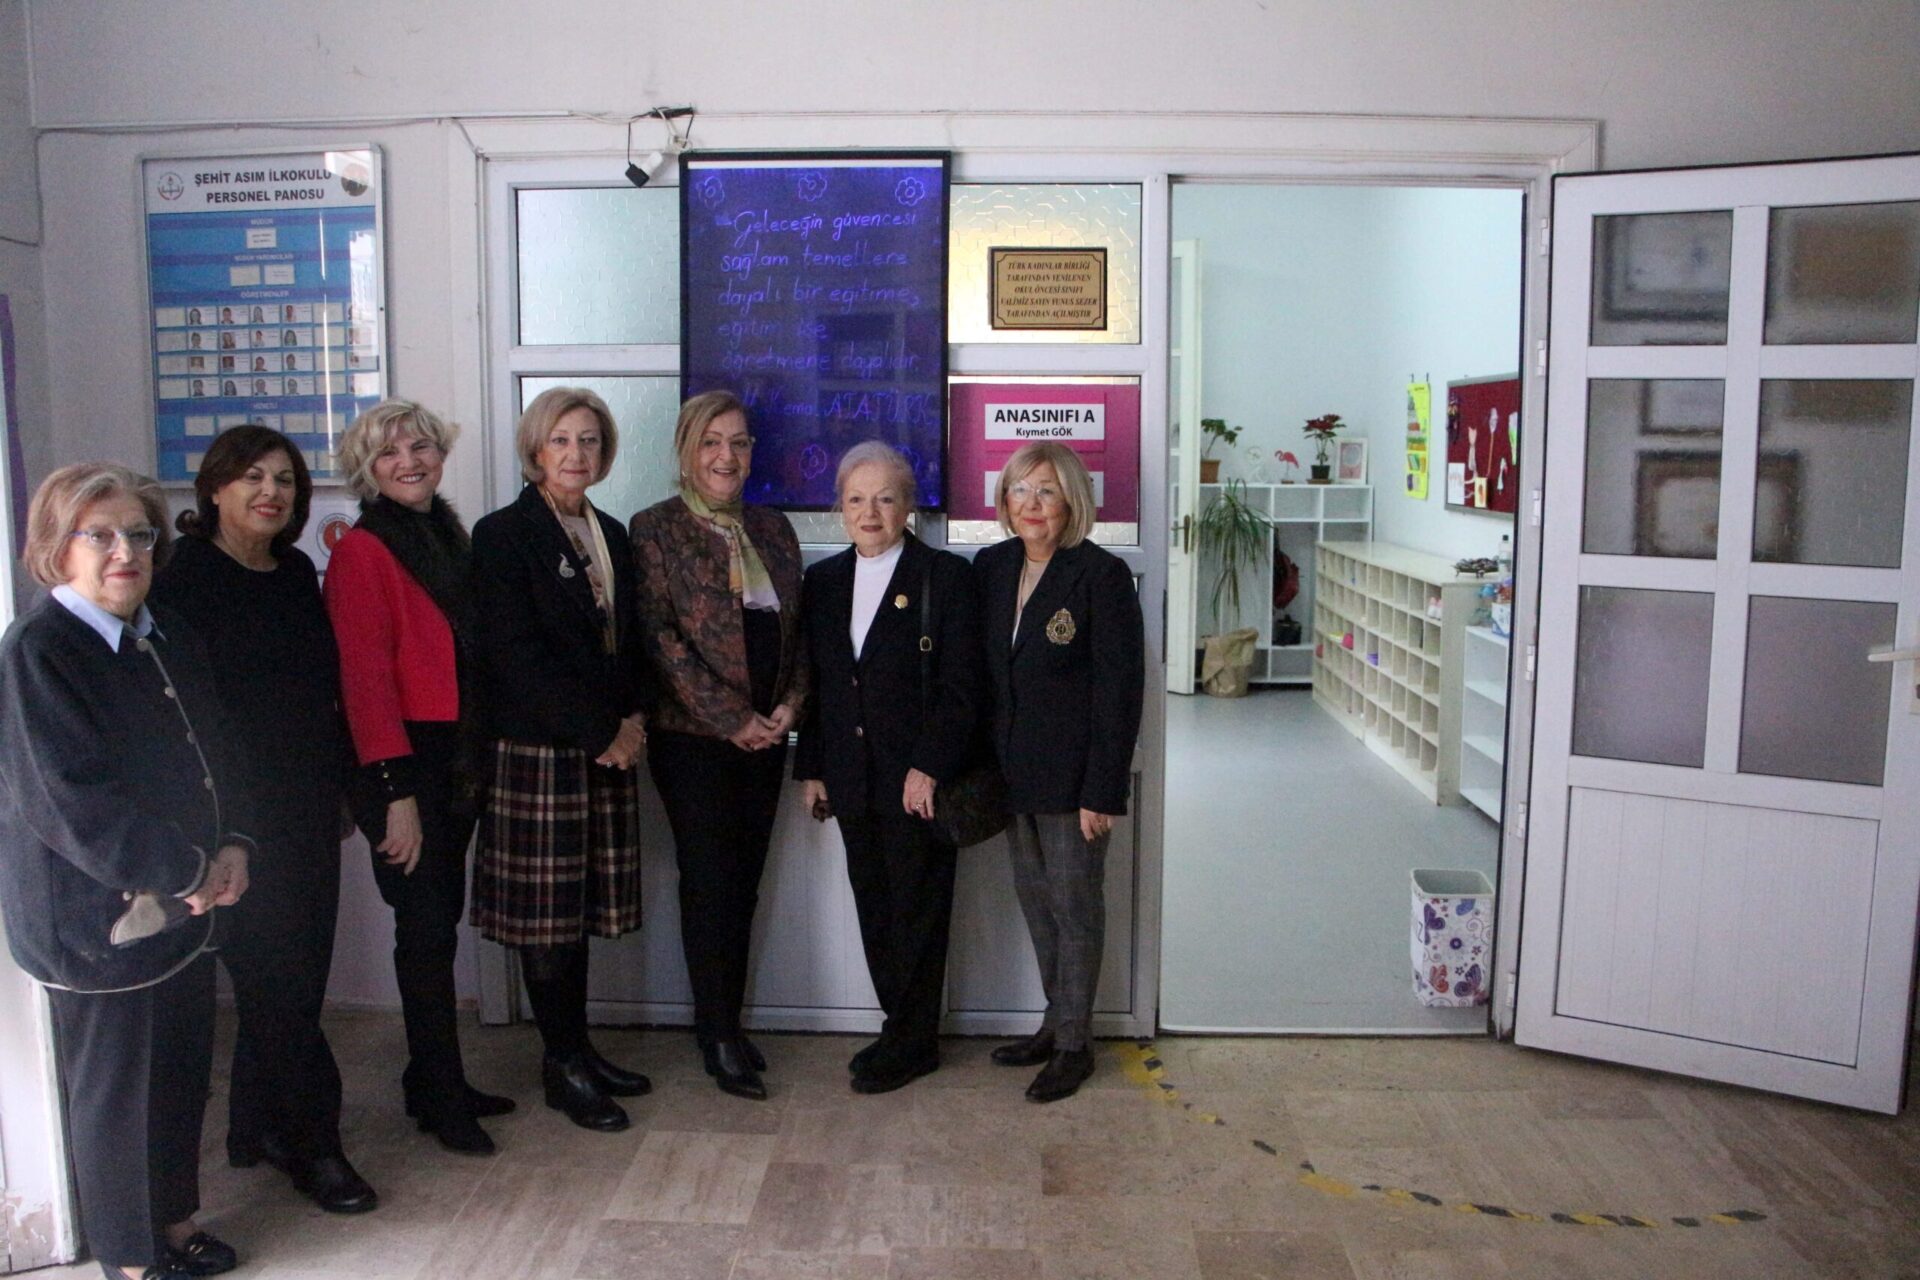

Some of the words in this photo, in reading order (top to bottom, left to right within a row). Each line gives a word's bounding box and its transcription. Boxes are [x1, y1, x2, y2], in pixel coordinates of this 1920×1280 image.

[194, 169, 231, 187] ŞEHİT
[235, 170, 265, 184] ASIM
[269, 168, 332, 182] İLKOKULU
[206, 190, 271, 203] PERSONEL
[275, 188, 324, 201] PANOSU
[734, 209, 823, 247] Geleceğin
[720, 240, 789, 281] sağlam
[803, 240, 909, 269] temellere
[1008, 261, 1026, 270] TÜRK
[1027, 262, 1062, 270] KADINLAR
[1064, 260, 1091, 270] BİRLİĞİ
[1007, 274, 1050, 282] TARAFINDAN
[1014, 285, 1033, 294] OKUL
[1034, 284, 1060, 294] ÖNCESİ
[1006, 309, 1050, 318] TARAFINDAN
[1052, 309, 1092, 319] AÇILMIŞTIR
[994, 409, 1079, 423] ANASINIFI
[1083, 409, 1095, 423] A
[1016, 427, 1049, 439] Kıymet
[1051, 425, 1073, 437] GÖK
